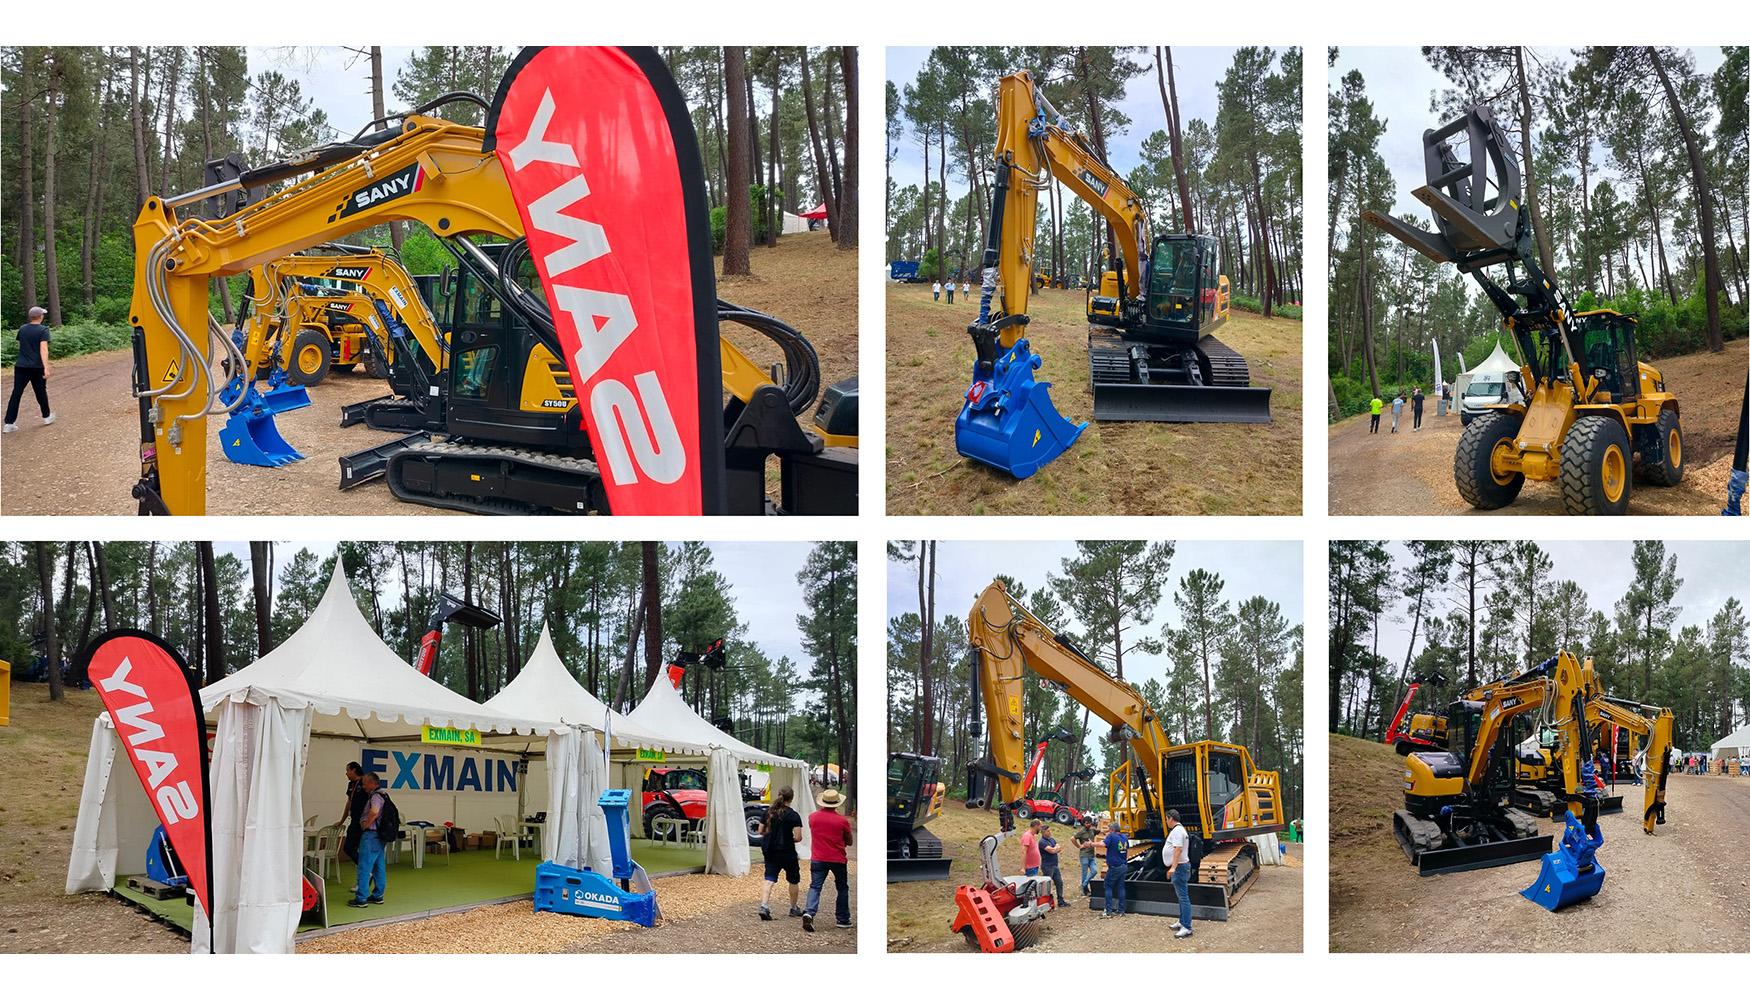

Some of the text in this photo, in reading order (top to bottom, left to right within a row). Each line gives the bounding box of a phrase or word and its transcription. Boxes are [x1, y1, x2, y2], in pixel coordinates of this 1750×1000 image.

[355, 173, 410, 208] SANY
[1085, 173, 1105, 194] SANY
[335, 268, 364, 277] SANY
[330, 302, 348, 310] SANY
[1554, 289, 1578, 332] SANY
[429, 728, 475, 743] EXMAIN, SA
[362, 749, 519, 792] EXMAIN
[584, 892, 619, 904] OKADA
